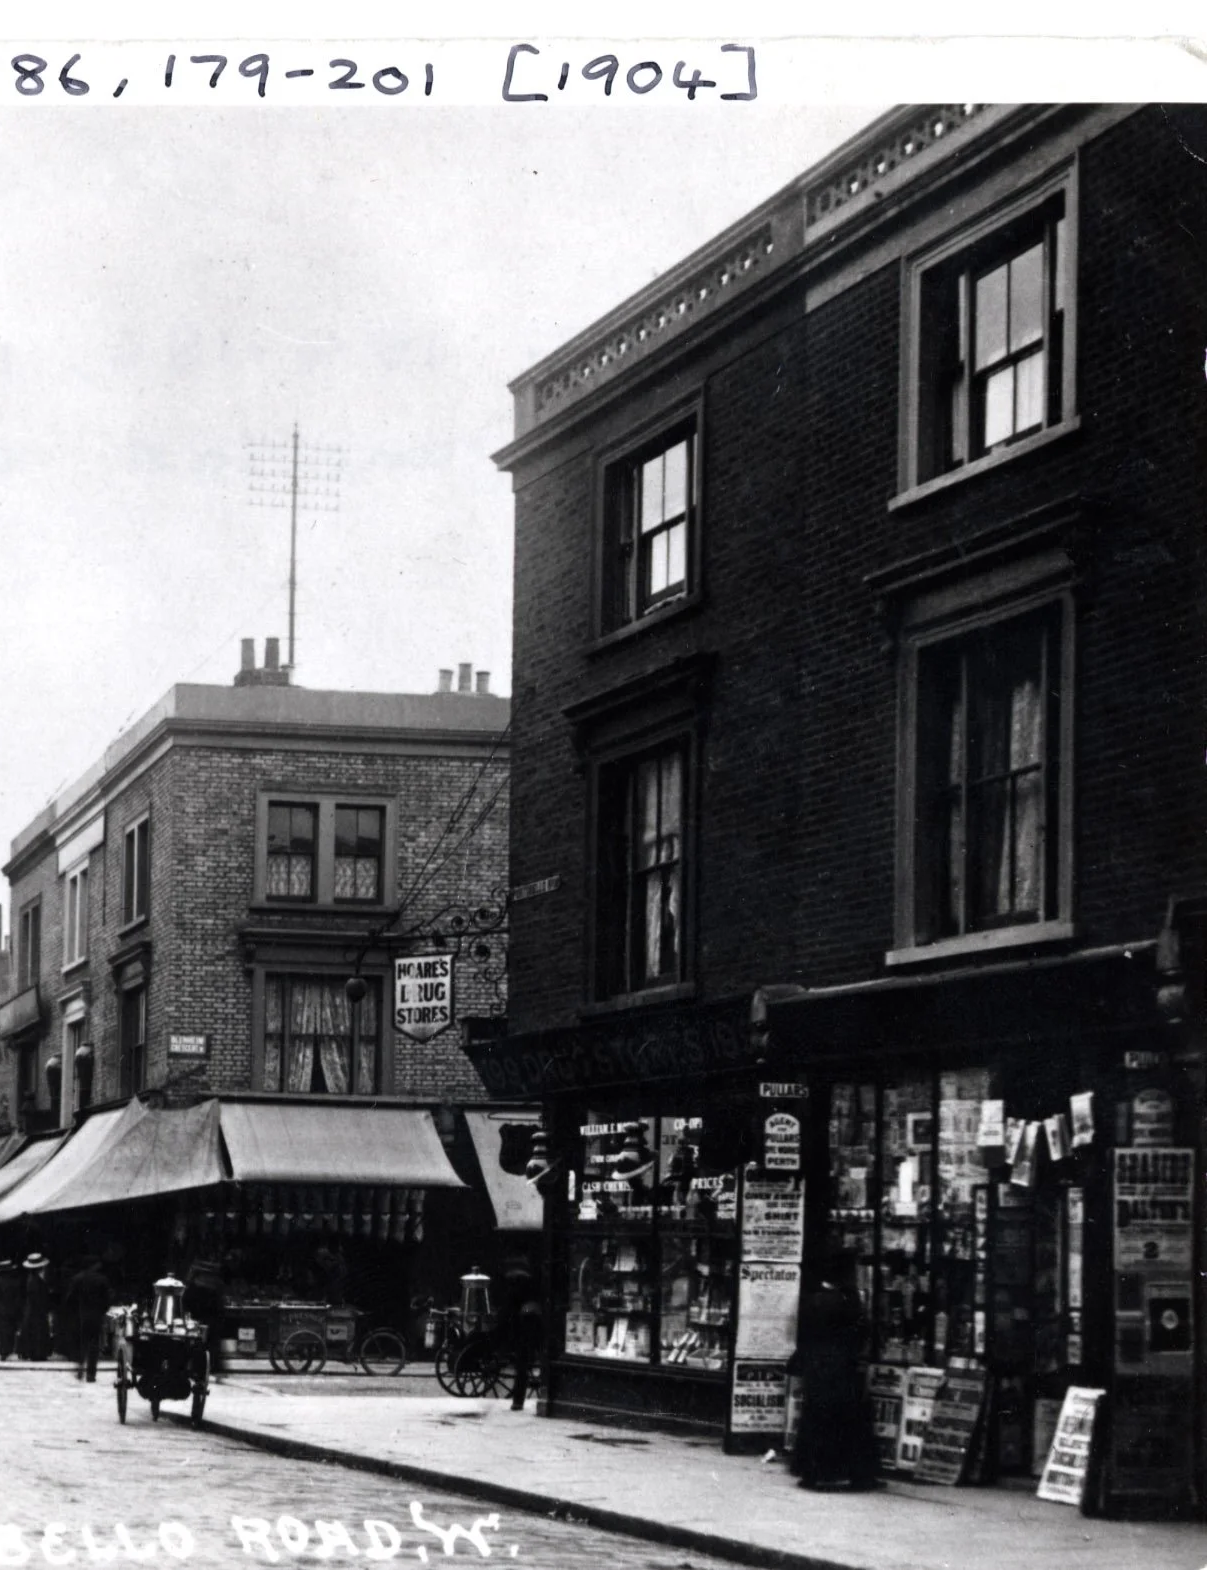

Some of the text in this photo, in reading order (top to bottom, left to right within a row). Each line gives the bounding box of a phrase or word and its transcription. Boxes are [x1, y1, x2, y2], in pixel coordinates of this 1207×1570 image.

[164, 54, 433, 98] 179-201
[397, 958, 448, 980] HOARE'S
[397, 1006, 448, 1024] STORES
[767, 1157, 798, 1167] PERTH
[582, 1181, 601, 1193] CASH
[691, 1177, 723, 1190] PRICES
[740, 1264, 798, 1282] Spectator
